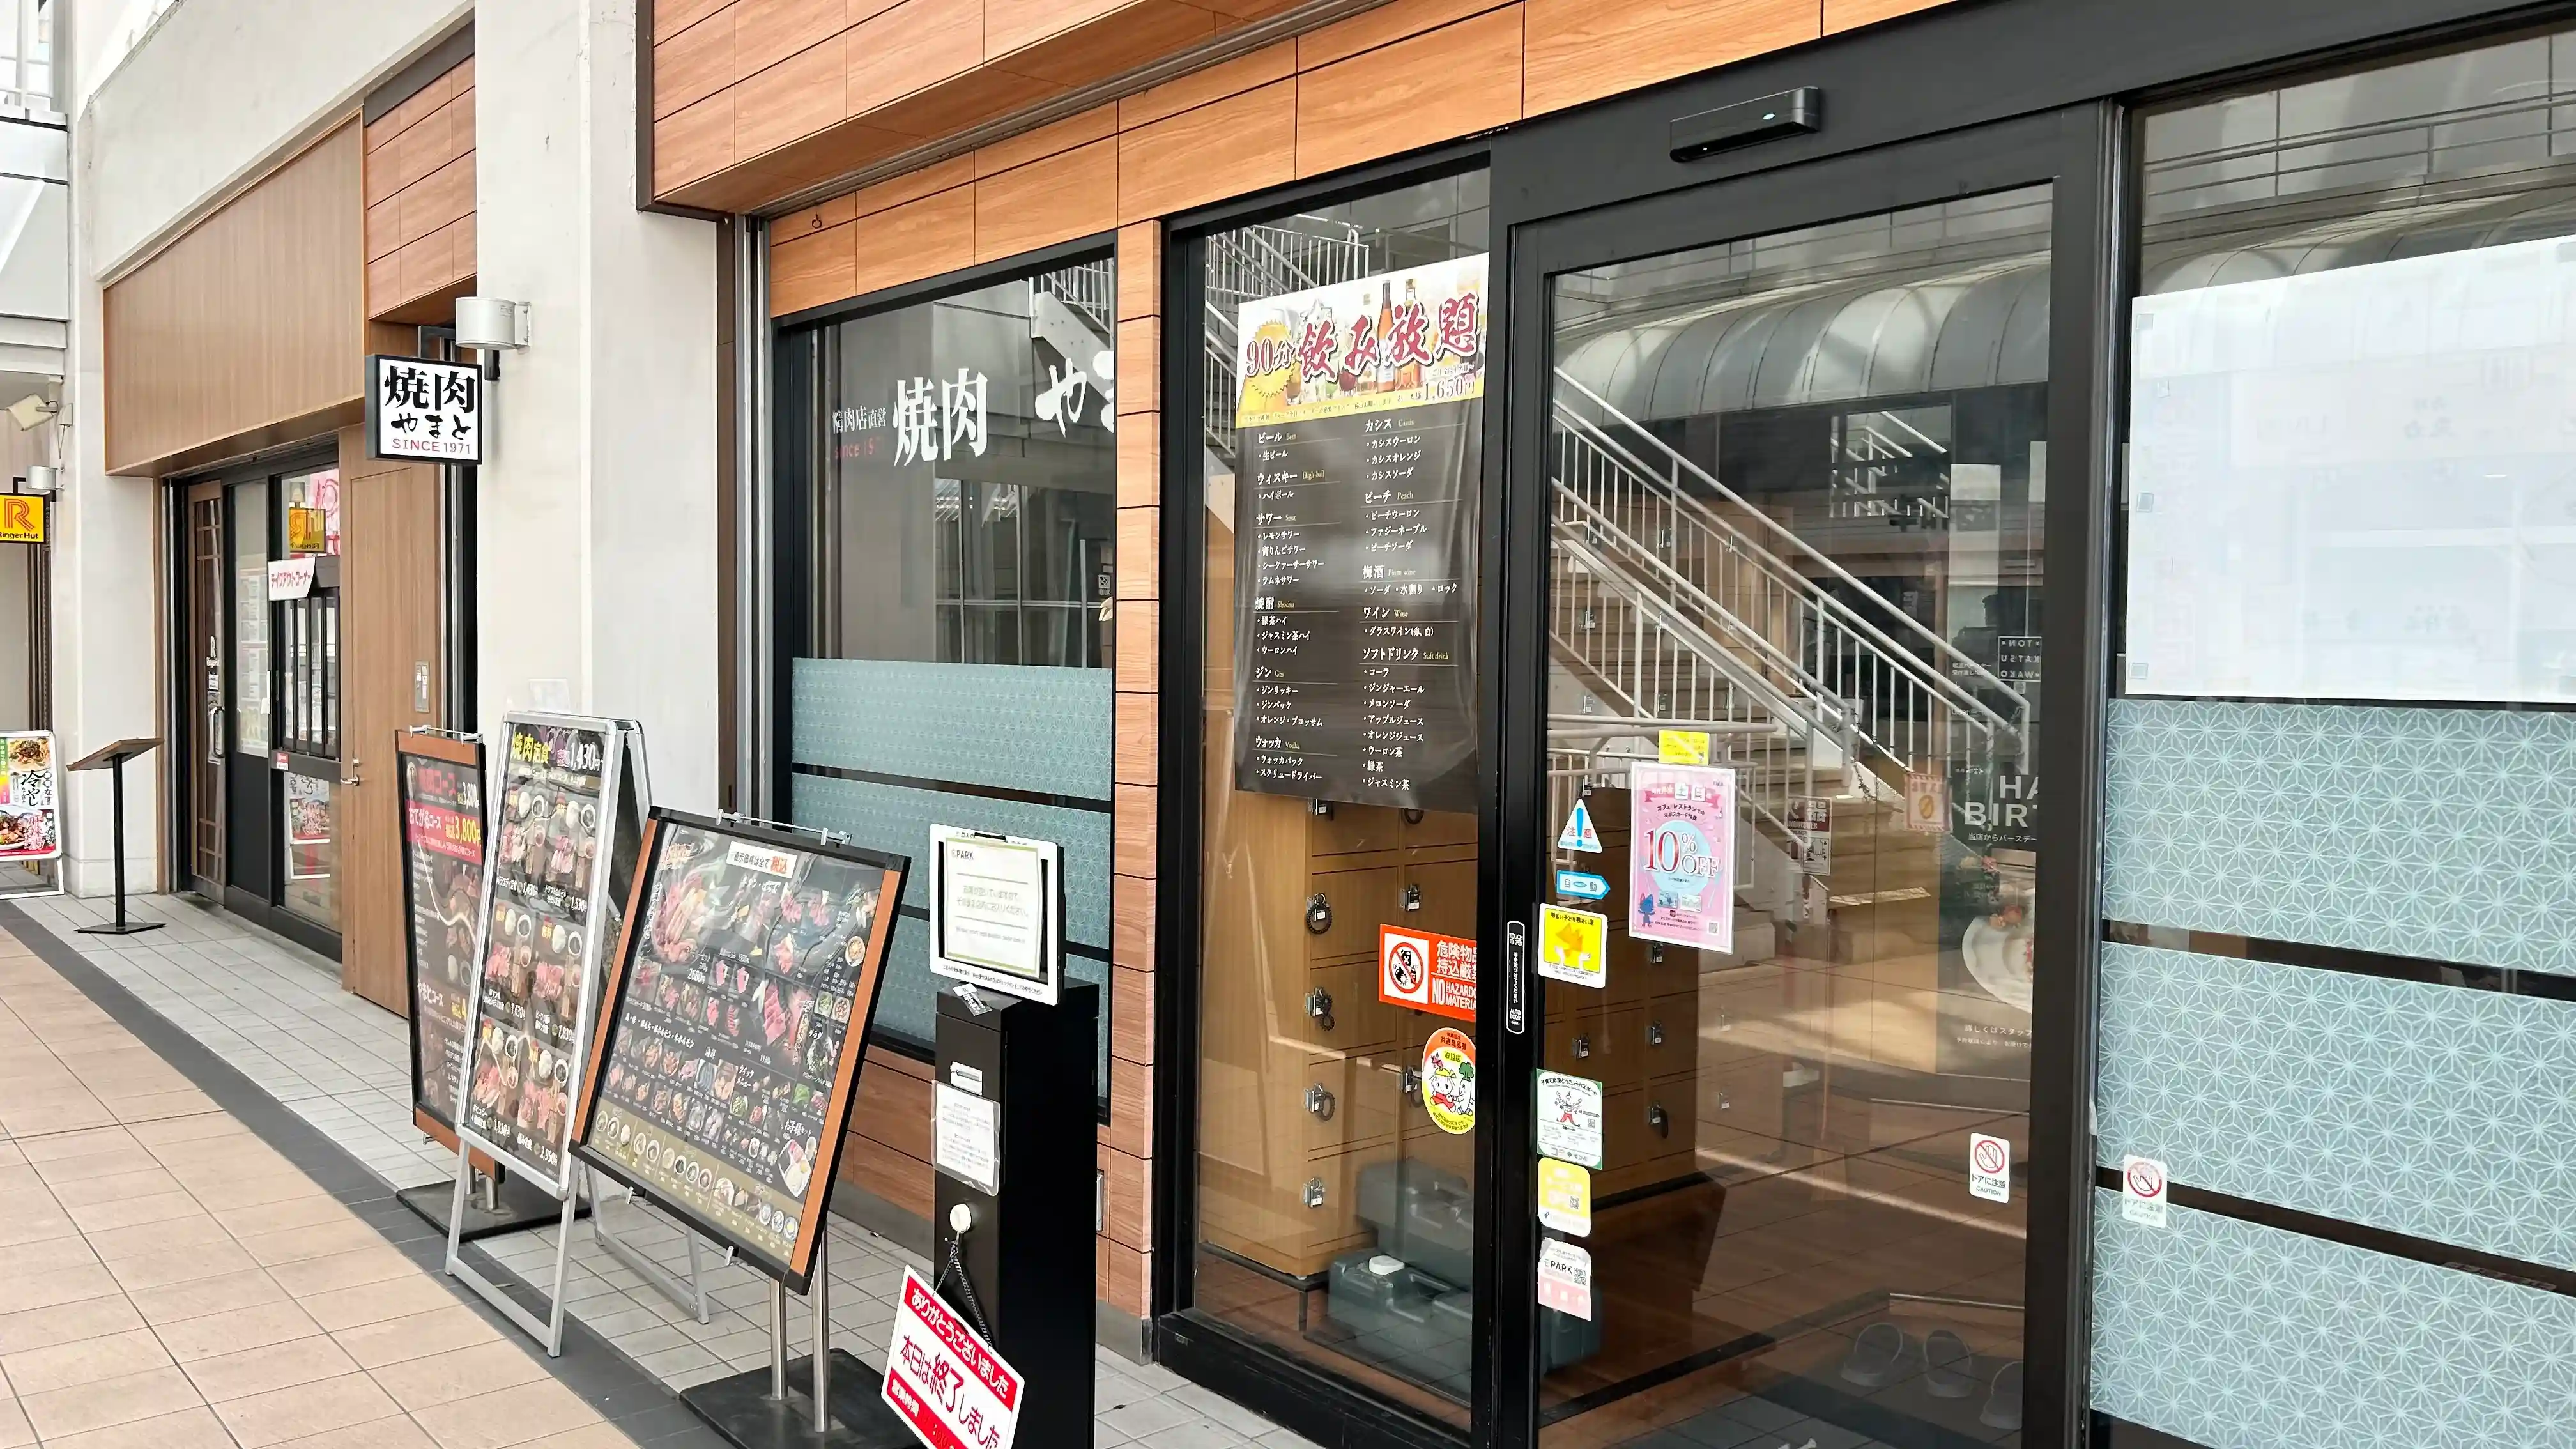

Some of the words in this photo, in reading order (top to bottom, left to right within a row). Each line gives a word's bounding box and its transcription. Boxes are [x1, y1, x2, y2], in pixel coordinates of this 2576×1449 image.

[1246, 338, 1296, 378] 90分
[1298, 291, 1480, 385] 飲み放題
[384, 365, 476, 414] 焼肉
[893, 367, 988, 467] 焼肉
[390, 413, 471, 440] やまと
[1365, 418, 1393, 433] カシス
[1257, 431, 1283, 445] ビール
[392, 438, 440, 452] SINCE
[443, 442, 471, 454] 1971
[1257, 470, 1298, 486] ウィスキー
[1365, 489, 1392, 504] ピーチ
[4, 498, 35, 532] R
[1255, 512, 1282, 526] サワー
[1362, 564, 1385, 579] 梅酒
[1255, 596, 1275, 611] 焼酎
[1363, 606, 1390, 620] ワイン
[1362, 647, 1420, 662] ソフトドリンク
[1255, 665, 1272, 679] ジン
[1255, 735, 1282, 749] ウォッカ
[1965, 801, 2038, 828] BIR
[1682, 854, 1720, 878] OFF
[1432, 977, 1446, 1006] NO
[1972, 1174, 2006, 1189] ドアに注意
[1975, 1185, 2002, 1197] CAUTION
